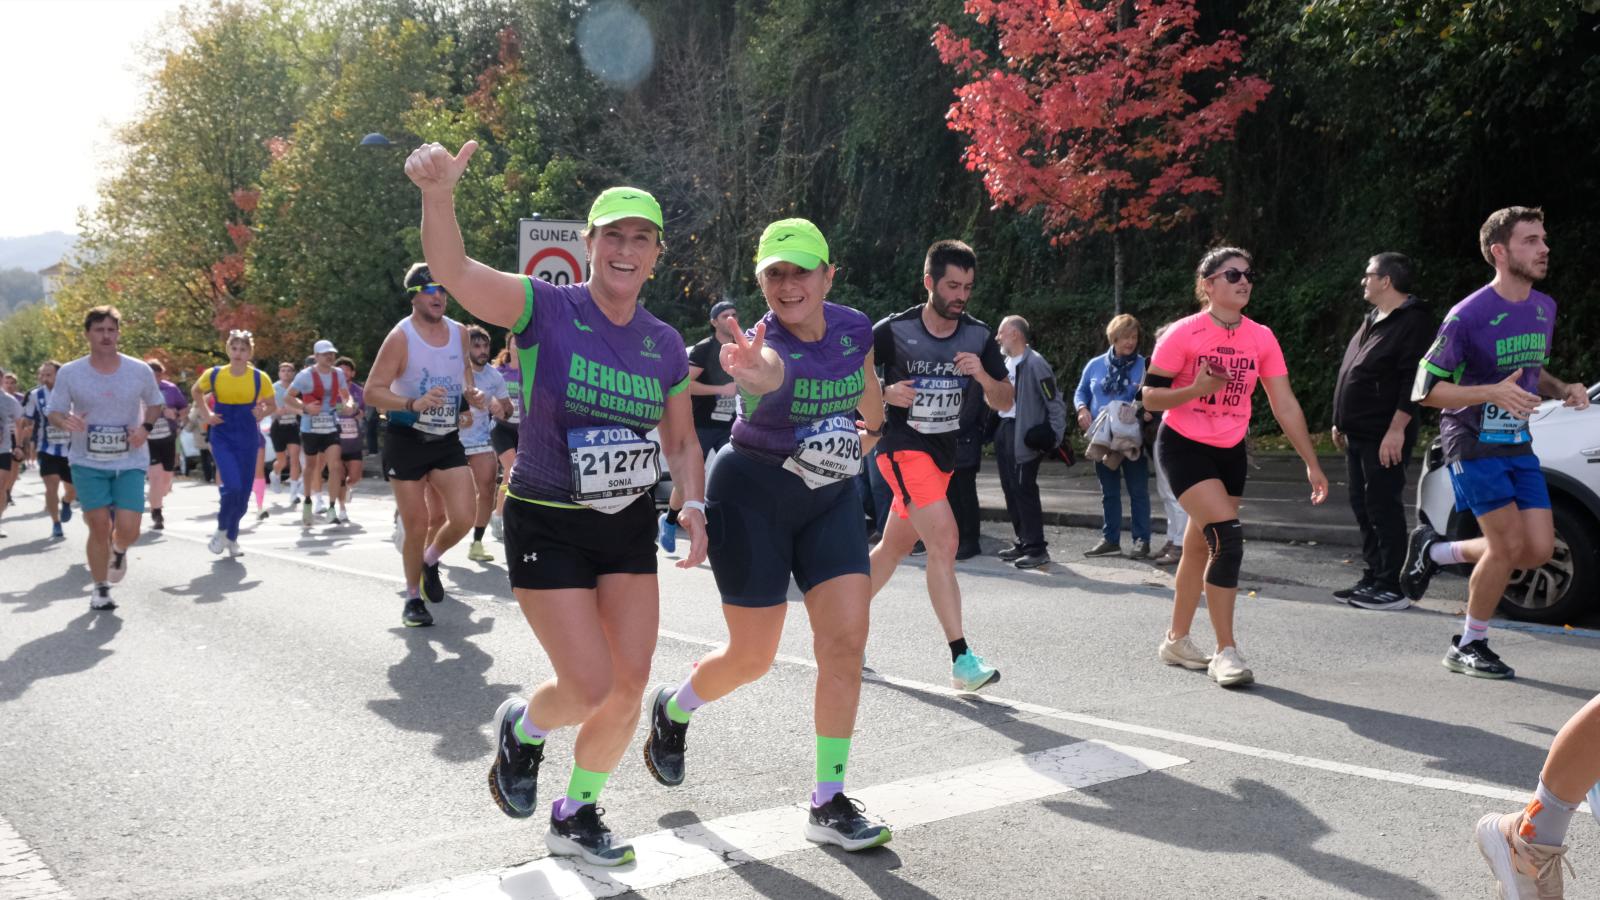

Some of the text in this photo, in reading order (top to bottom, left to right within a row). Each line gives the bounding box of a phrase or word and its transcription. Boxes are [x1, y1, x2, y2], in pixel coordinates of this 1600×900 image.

[529, 228, 578, 242] GUNEA
[1496, 333, 1546, 357] BEHOBIA
[569, 352, 664, 403] BEHOBIA
[566, 382, 597, 406] SAN
[1225, 382, 1248, 395] RRI
[915, 392, 961, 408] 27170
[1222, 395, 1241, 407] KO
[423, 407, 456, 417] 28038
[790, 401, 818, 416] SAN
[91, 434, 126, 445] 23314
[581, 448, 654, 476] 21277
[819, 459, 847, 471] ARRITXU
[608, 478, 632, 488] SONIA
